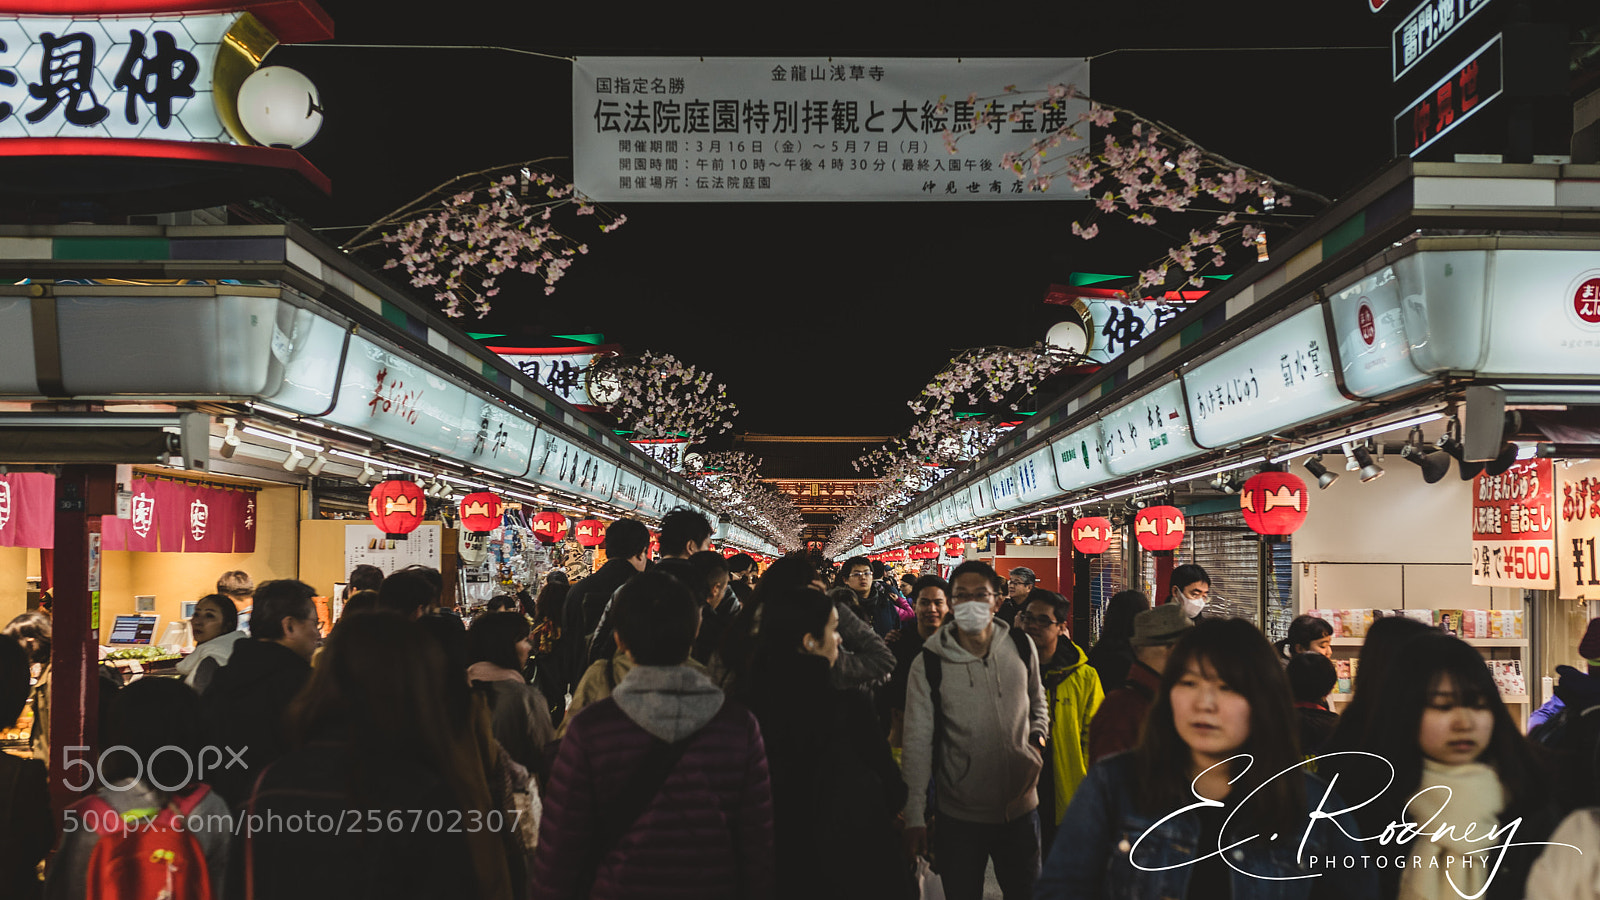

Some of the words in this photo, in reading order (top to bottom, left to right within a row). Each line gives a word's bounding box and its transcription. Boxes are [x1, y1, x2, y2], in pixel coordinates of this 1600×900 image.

[771, 64, 885, 82] 金龍山浅草寺
[596, 77, 685, 95] 国指定名勝
[1478, 469, 1540, 502] あげまんじゅう
